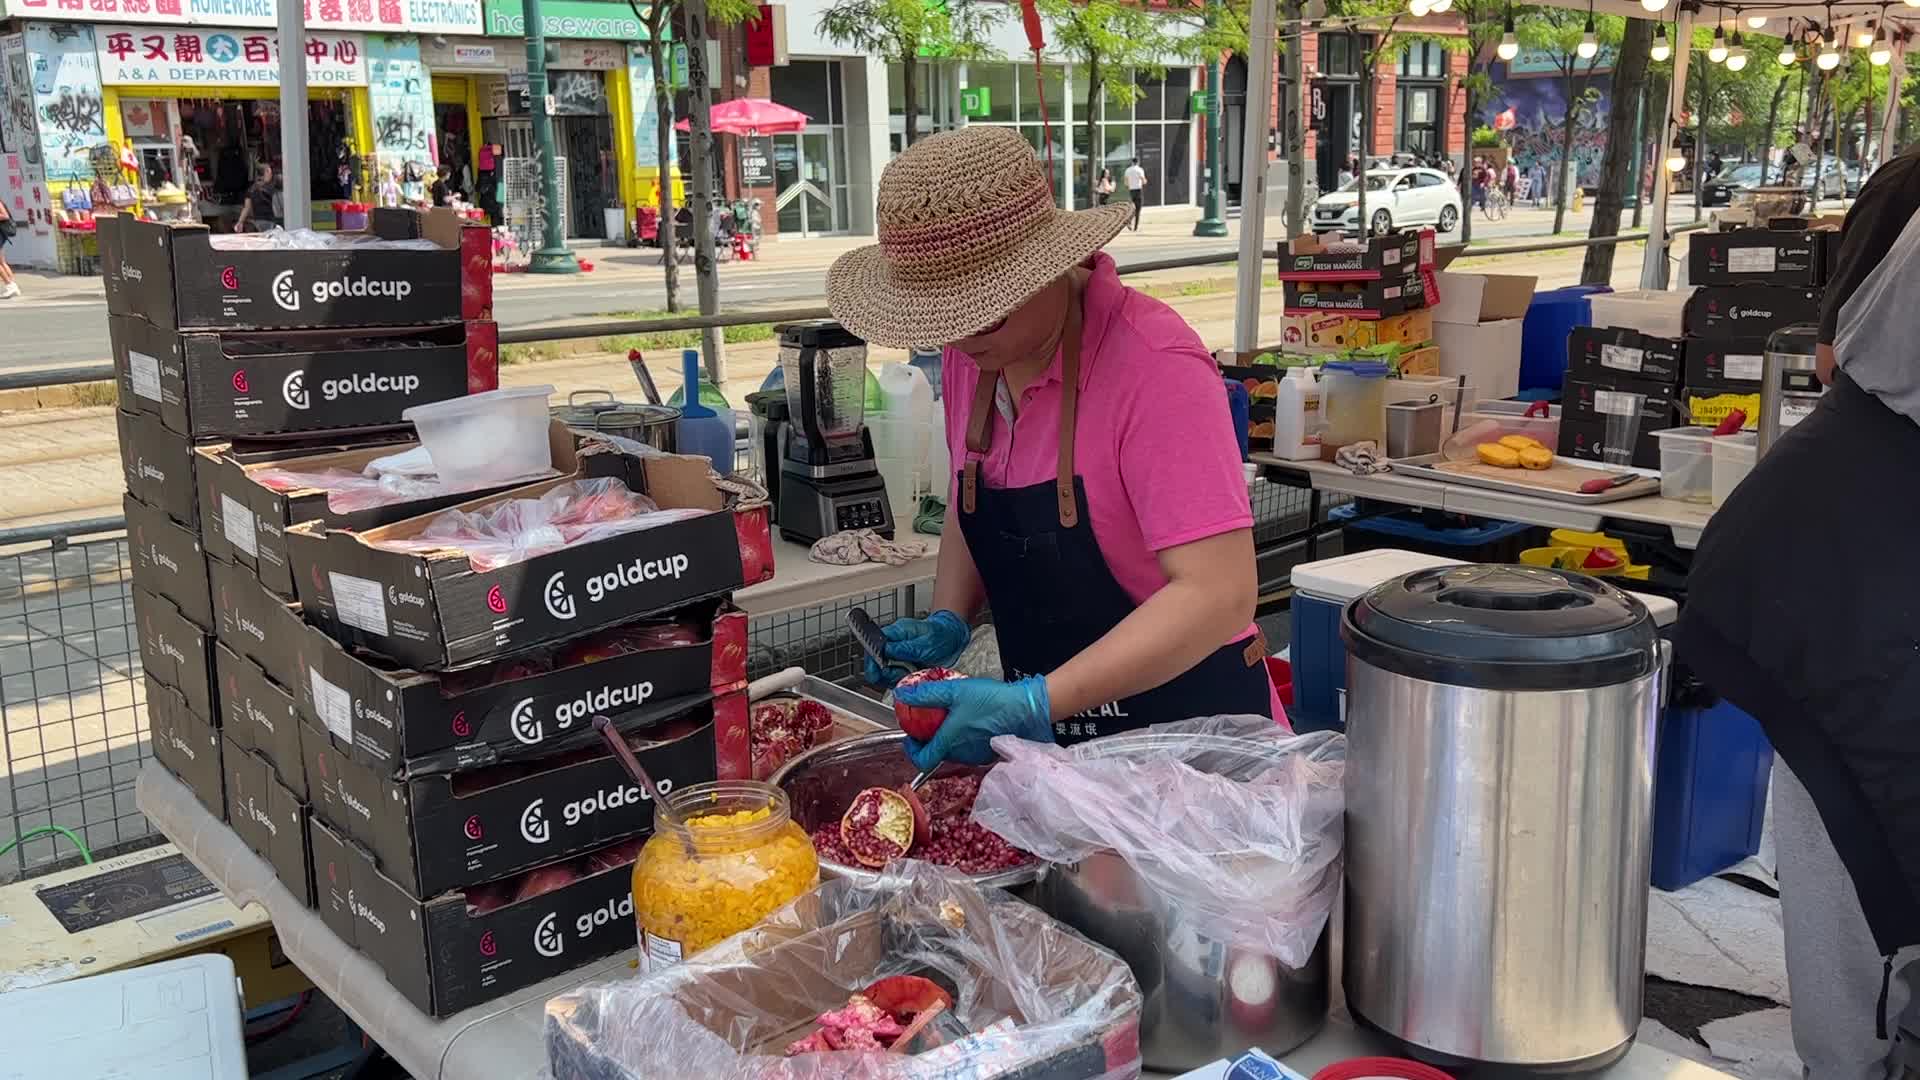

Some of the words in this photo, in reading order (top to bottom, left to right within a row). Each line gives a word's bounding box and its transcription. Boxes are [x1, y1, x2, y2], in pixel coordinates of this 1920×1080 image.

[191, 0, 272, 16] HOMEWARE
[411, 1, 477, 24] ELECTRONICS
[493, 11, 638, 36] hoseware
[170, 68, 279, 81] DEPARTMEN
[312, 276, 411, 303] goldcup
[1740, 309, 1772, 319] goldcup
[322, 373, 419, 400] goldcup
[586, 553, 689, 602] goldcup
[555, 681, 654, 729] goldcup
[576, 892, 634, 937] gold
